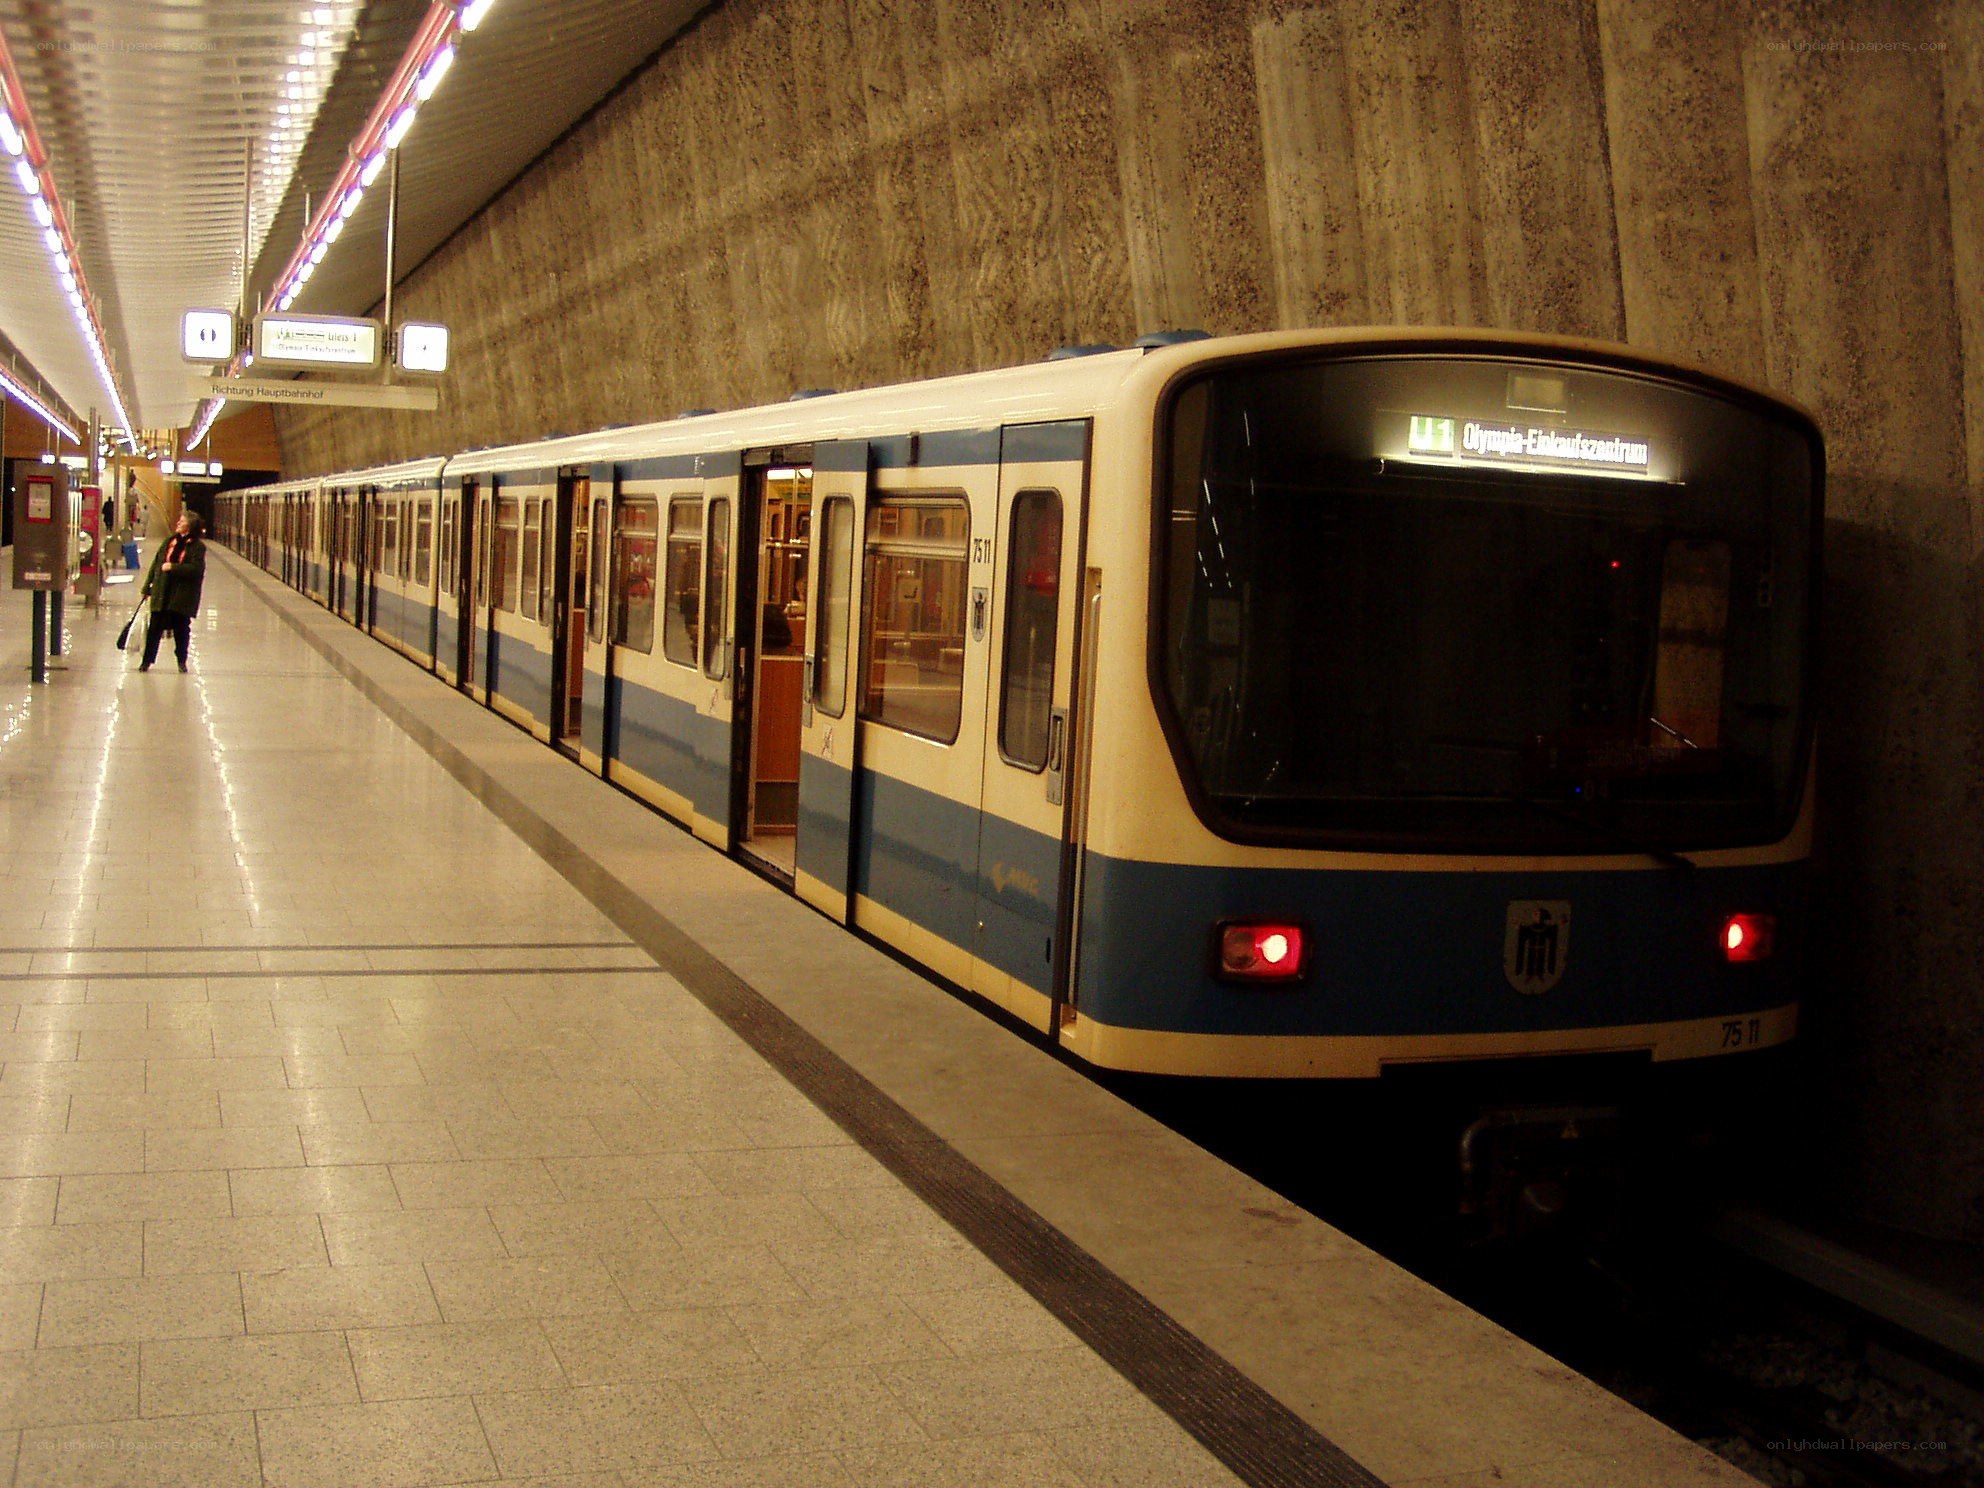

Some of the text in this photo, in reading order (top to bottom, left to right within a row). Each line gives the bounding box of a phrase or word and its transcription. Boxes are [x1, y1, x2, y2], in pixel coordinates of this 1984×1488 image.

[211, 385, 324, 399] Richtung Hauptbahnhof
[1462, 422, 1648, 465] Olympia-Einkaufszentrum
